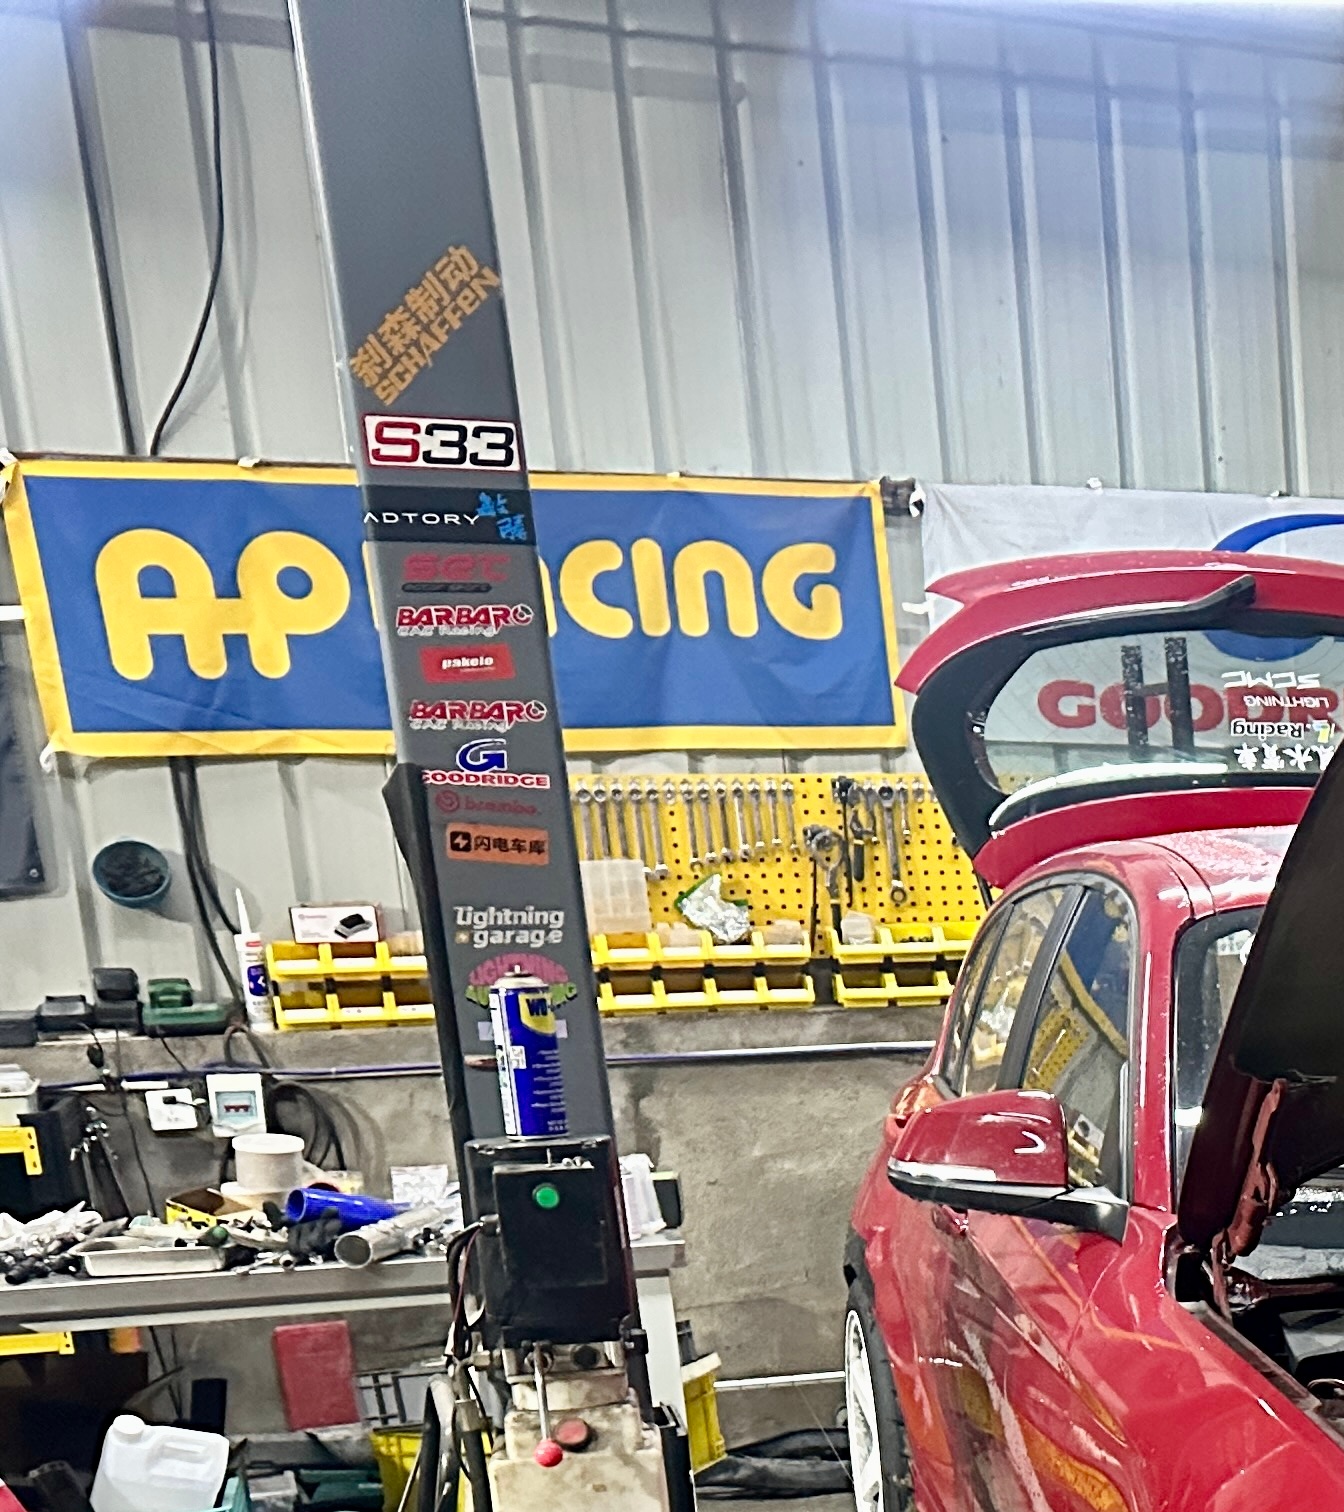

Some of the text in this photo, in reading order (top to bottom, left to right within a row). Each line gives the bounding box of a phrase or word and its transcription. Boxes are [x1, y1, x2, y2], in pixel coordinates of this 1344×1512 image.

[371, 421, 514, 467] S33
[95, 528, 351, 681] AP
[1243, 695, 1330, 709] LIGHTNING
[472, 929, 563, 949] garage
